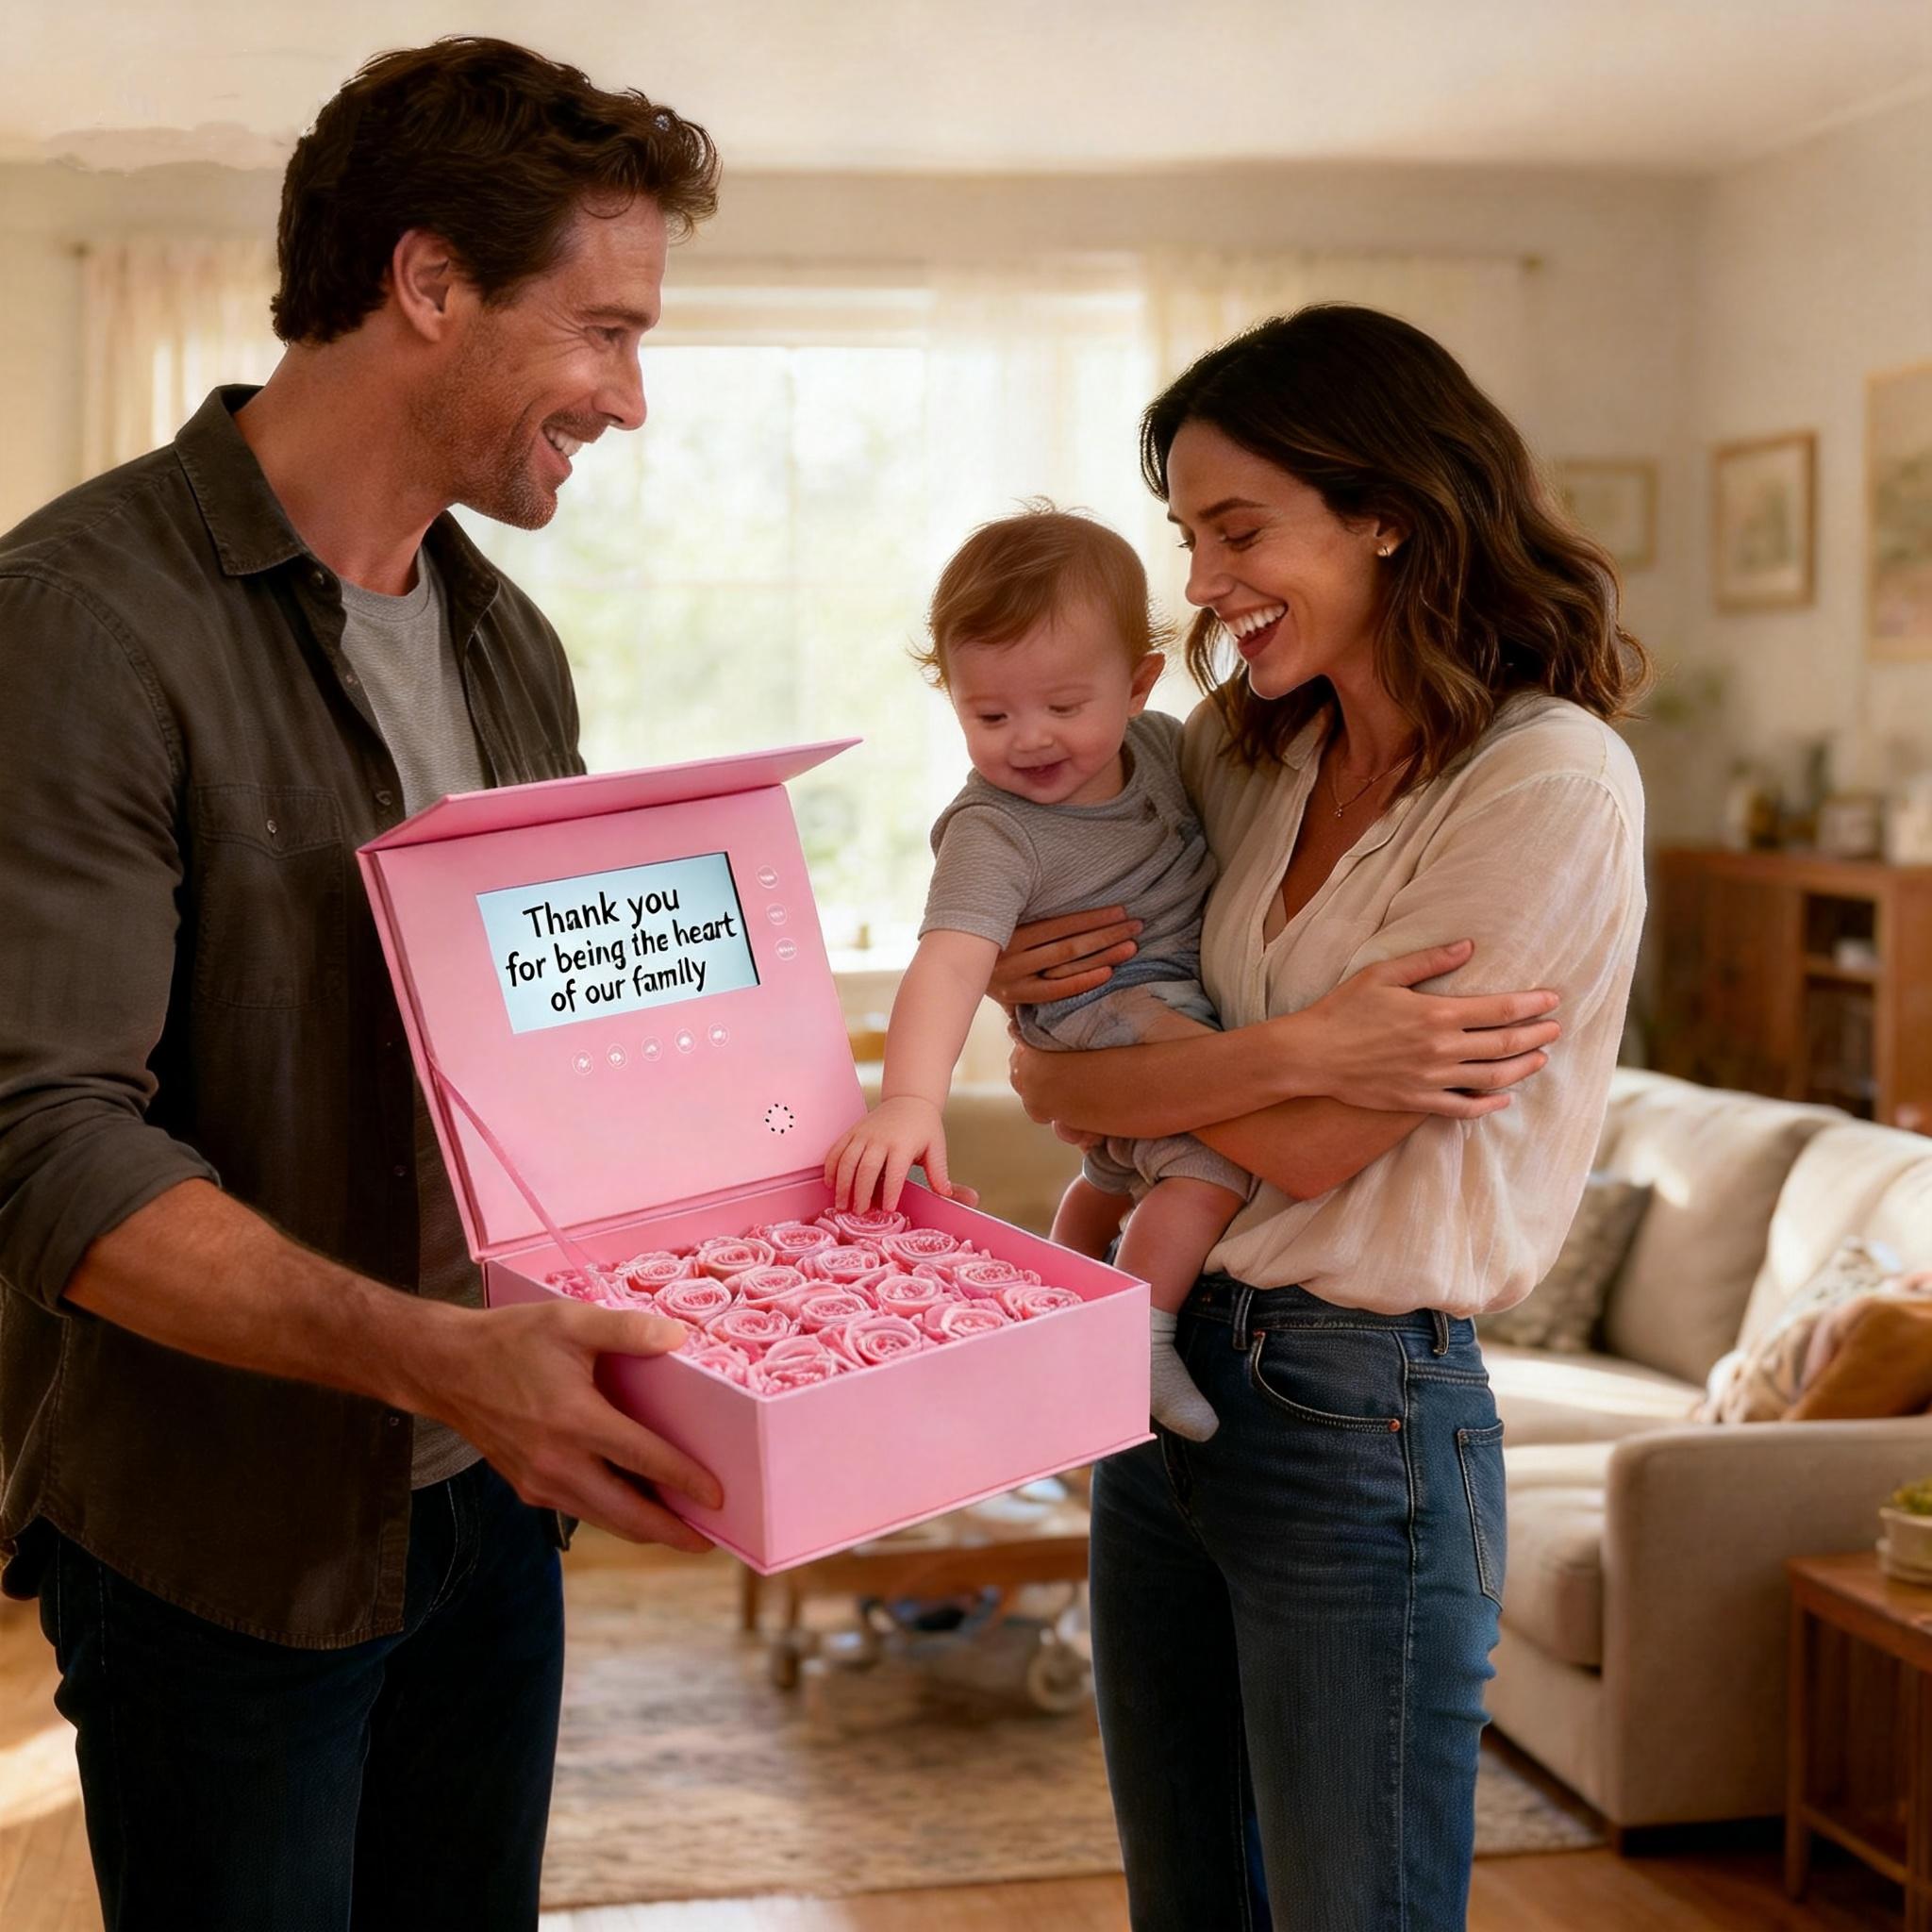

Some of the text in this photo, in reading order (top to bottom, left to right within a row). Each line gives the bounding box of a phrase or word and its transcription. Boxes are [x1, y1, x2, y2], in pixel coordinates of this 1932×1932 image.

[523, 890, 680, 937] Thank you
[506, 911, 737, 988] for being the heart
[551, 979, 576, 1012] of
[586, 979, 626, 1005] our
